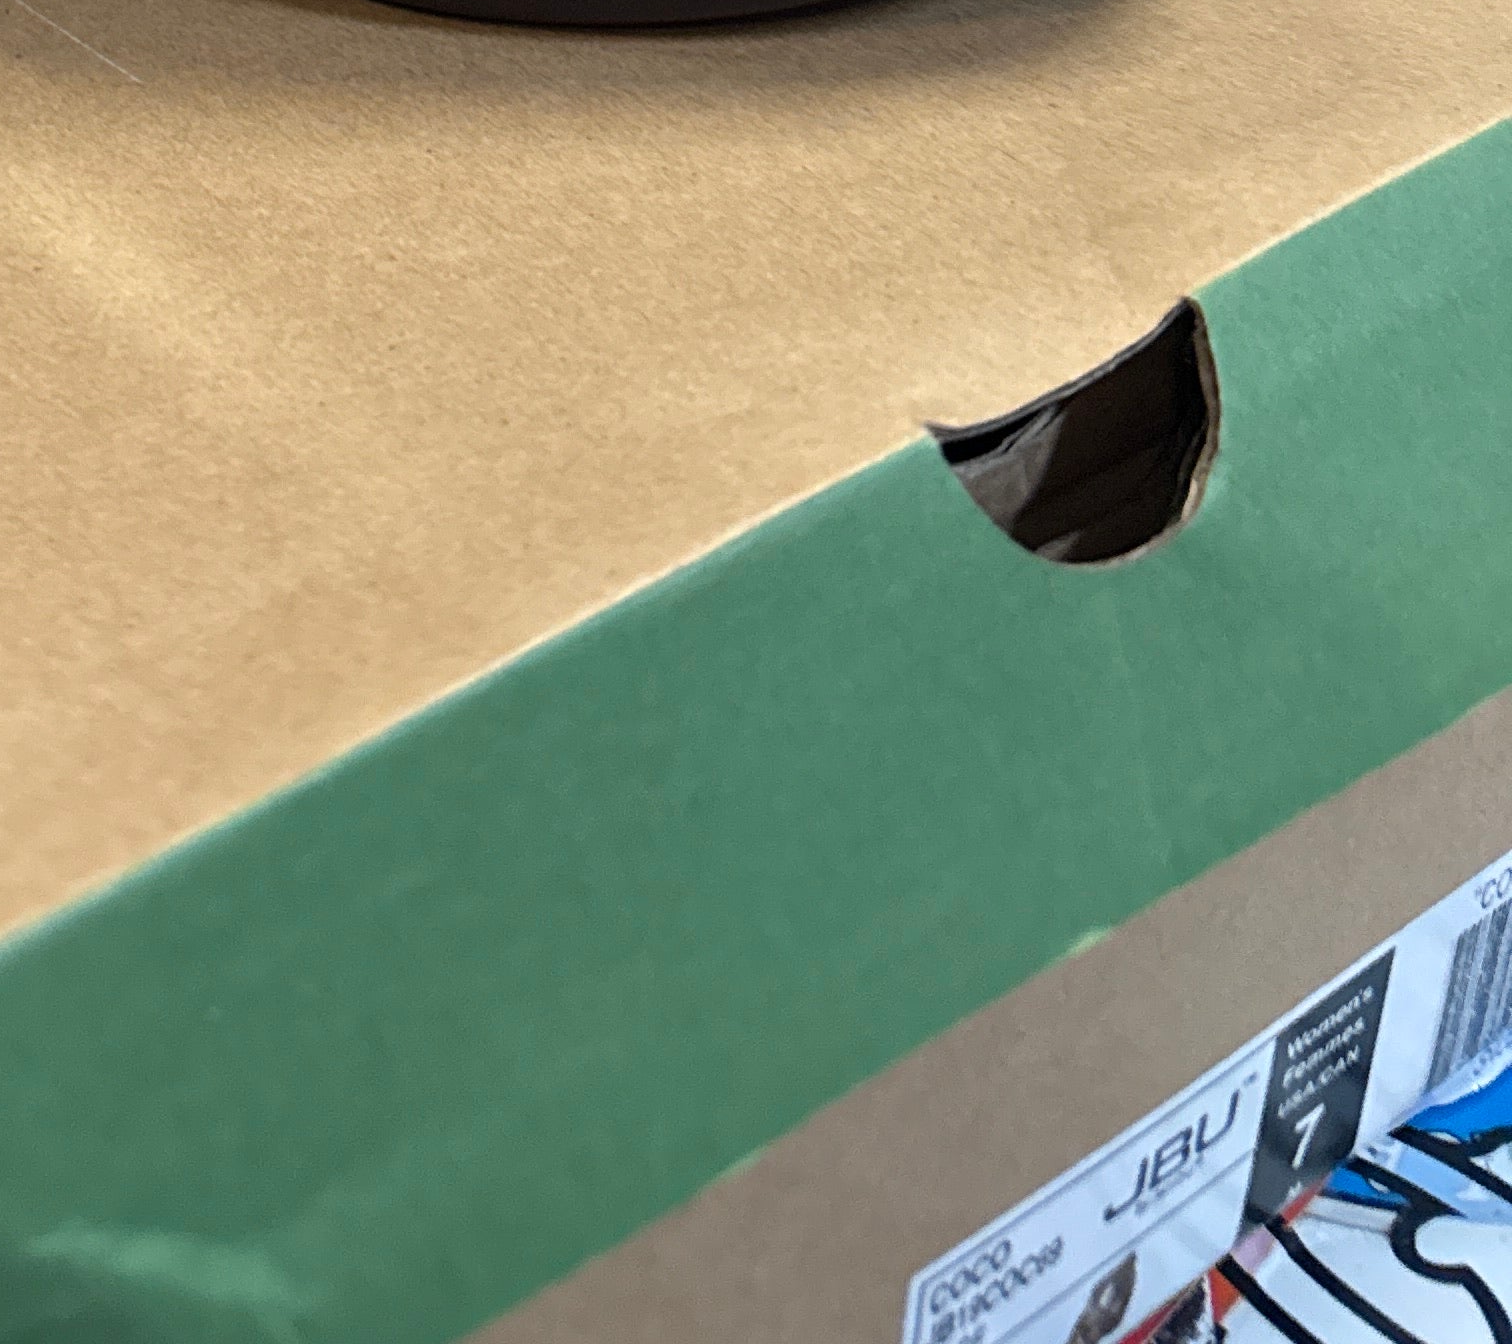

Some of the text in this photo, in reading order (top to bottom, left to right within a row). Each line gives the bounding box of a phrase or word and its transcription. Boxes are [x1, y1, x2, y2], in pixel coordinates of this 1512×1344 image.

[1281, 1016, 1366, 1090] Femmes
[1286, 984, 1375, 1060] Women's
[1102, 1087, 1240, 1223] JBU
[1294, 1102, 1326, 1171] 7
[929, 1238, 1012, 1314] COCO
